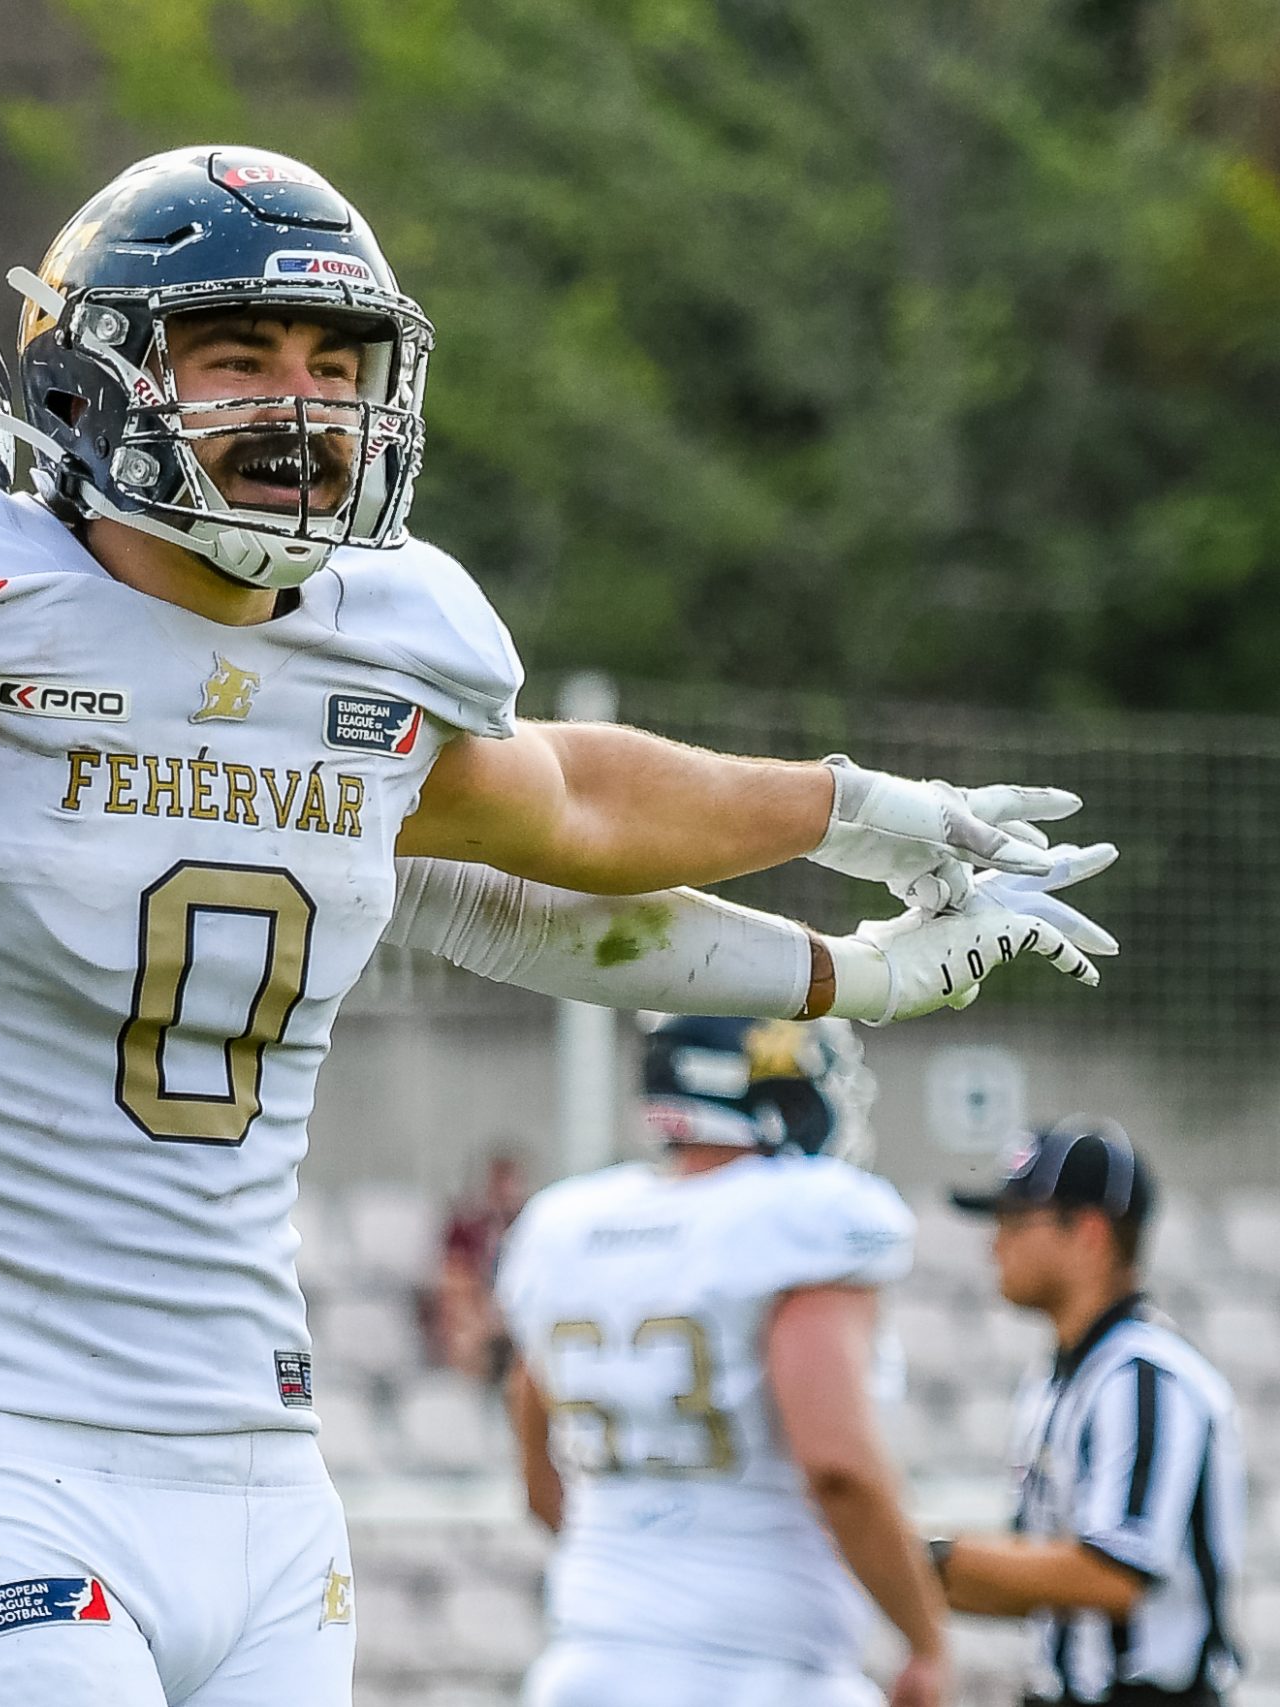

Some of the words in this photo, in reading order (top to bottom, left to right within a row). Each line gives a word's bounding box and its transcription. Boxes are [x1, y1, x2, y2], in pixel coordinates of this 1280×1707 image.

[337, 701, 390, 717] EUROPEAN
[337, 713, 376, 729] LEAGUE
[336, 726, 385, 743] FOOTBALL
[62, 746, 365, 838] FEHÉRVÁR
[115, 858, 318, 1148] 0
